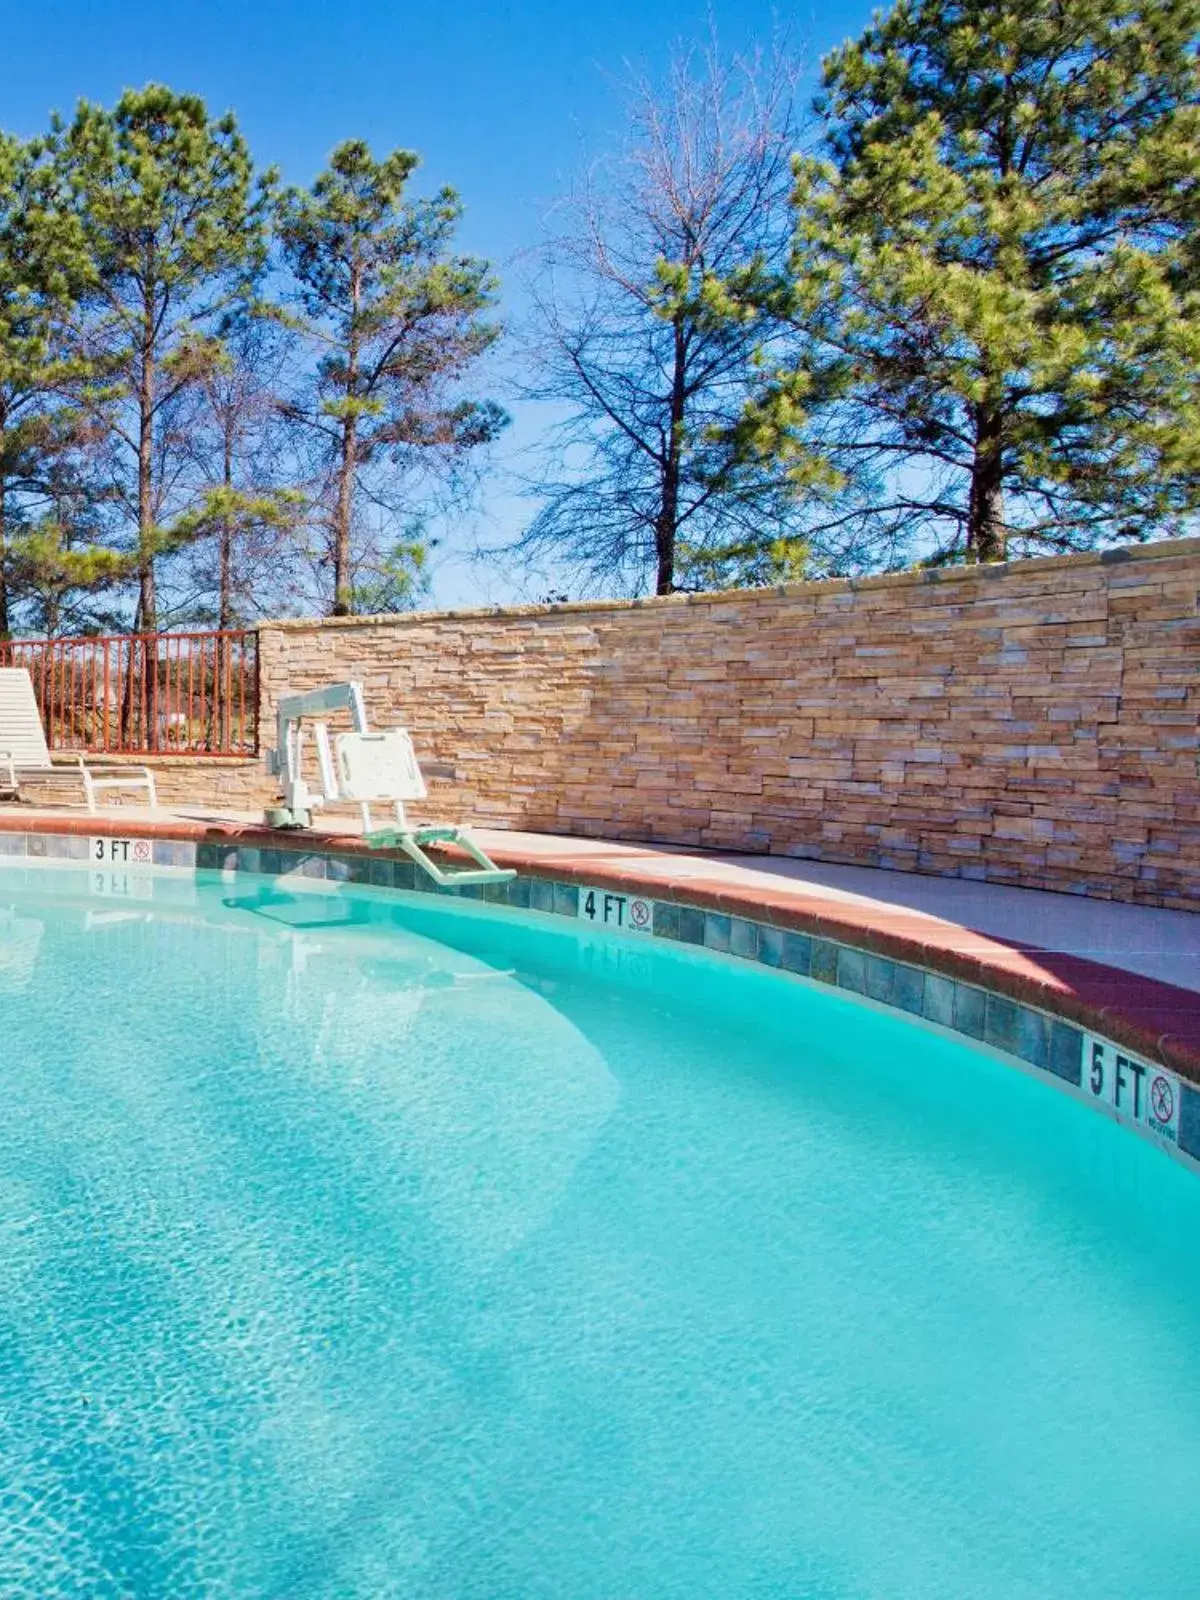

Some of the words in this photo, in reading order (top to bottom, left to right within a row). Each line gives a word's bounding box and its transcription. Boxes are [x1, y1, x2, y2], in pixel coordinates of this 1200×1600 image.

[96, 839, 104, 859] 3
[111, 841, 130, 861] FT
[585, 891, 596, 920] 4
[604, 894, 627, 926] FT
[1091, 1042, 1104, 1096] 5
[1115, 1054, 1146, 1118] FT
